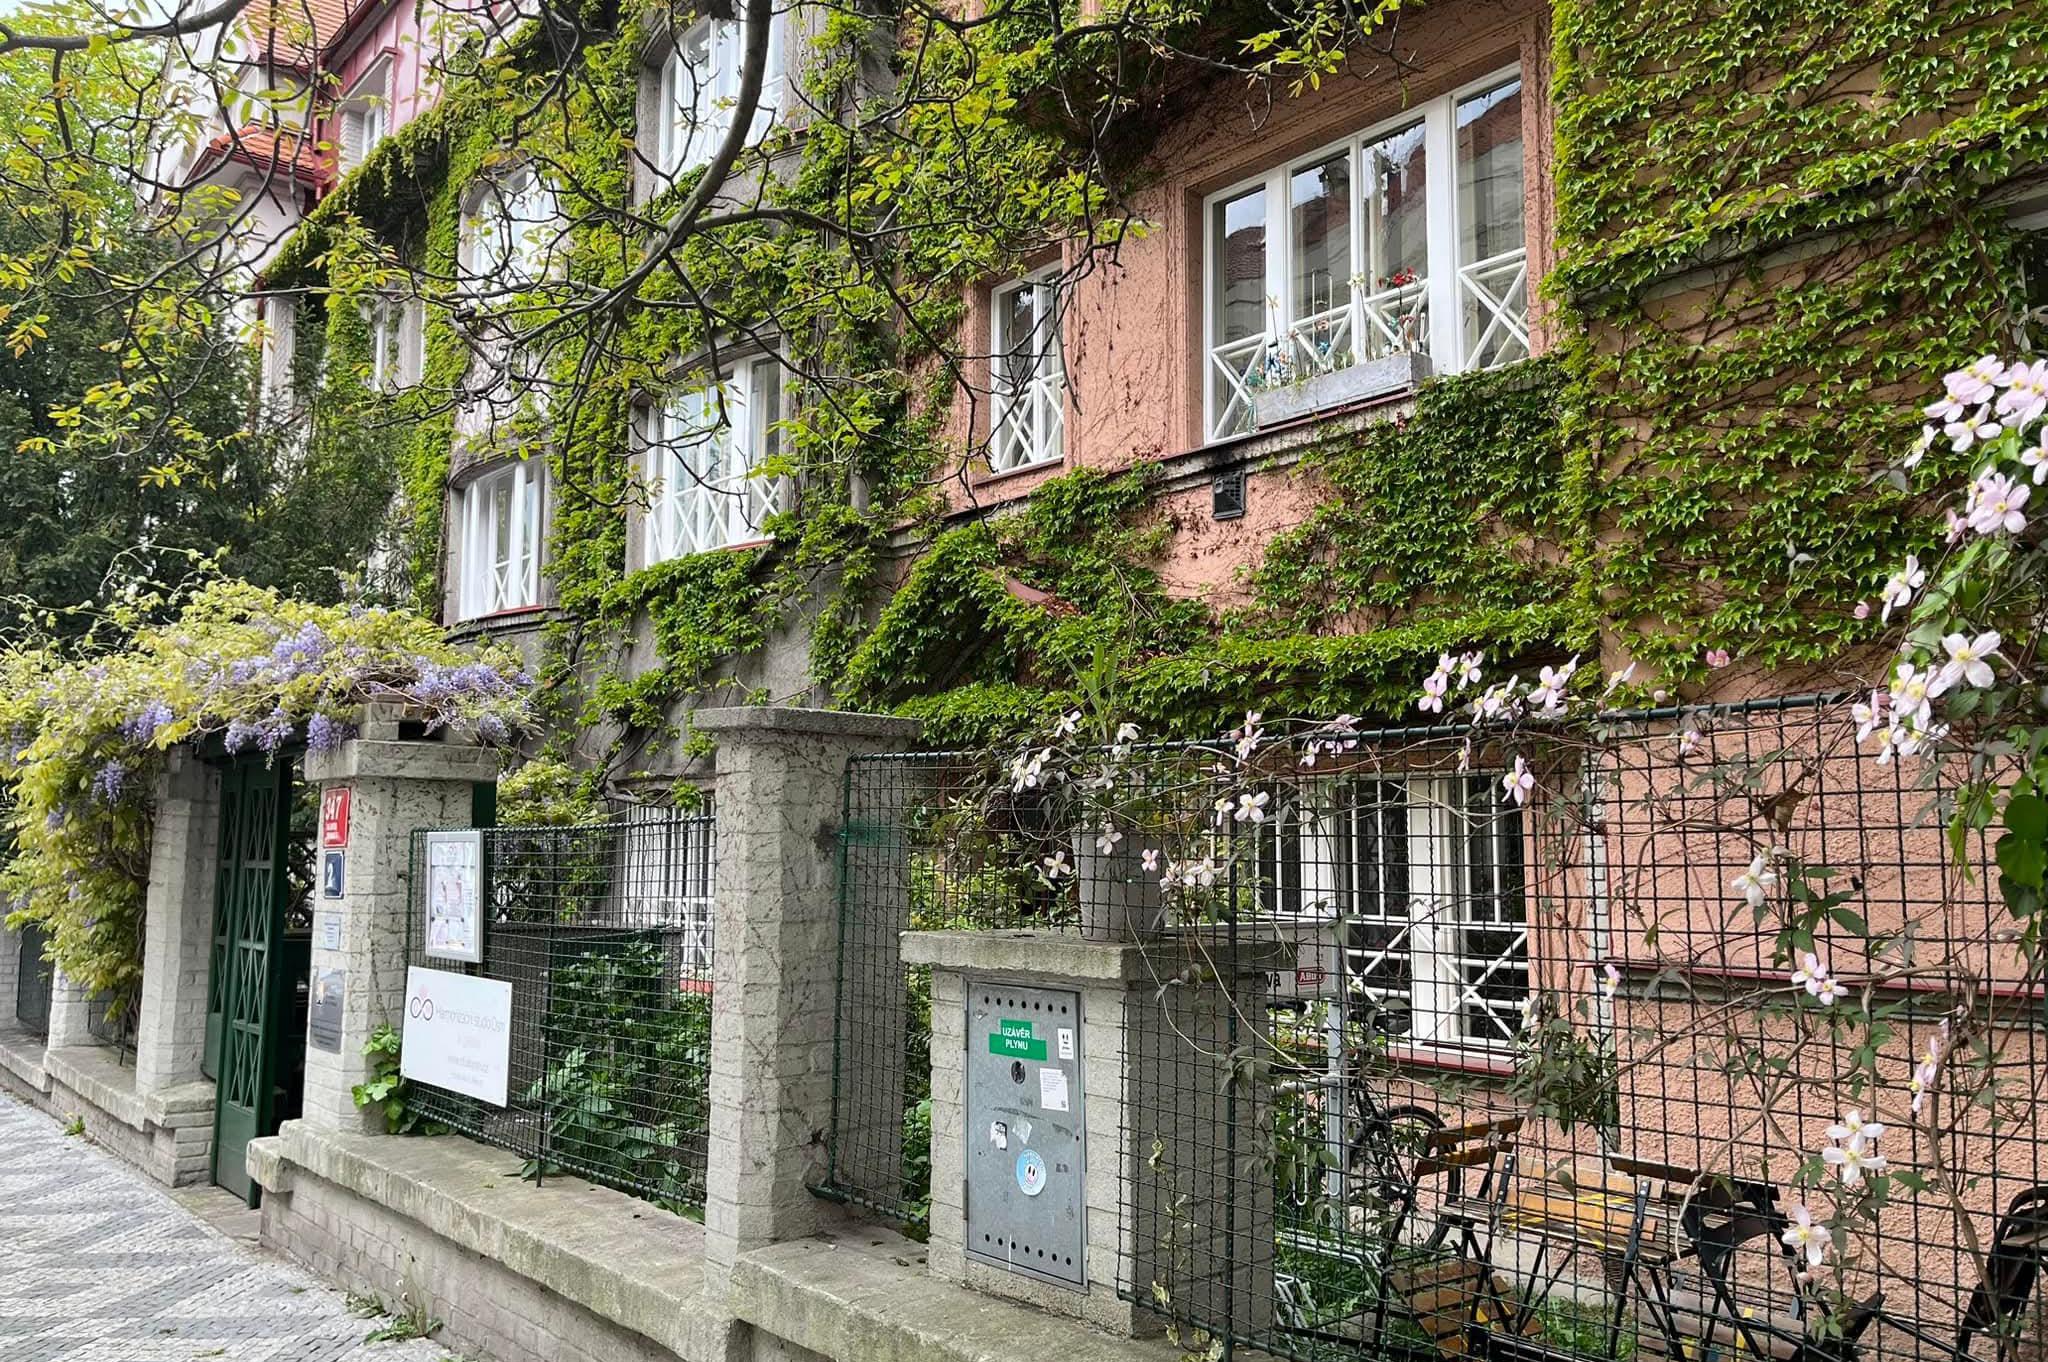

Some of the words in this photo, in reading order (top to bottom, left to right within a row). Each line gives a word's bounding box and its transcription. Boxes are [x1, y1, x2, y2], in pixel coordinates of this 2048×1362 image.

[325, 795, 342, 820] 347
[326, 863, 334, 888] 2
[1002, 1026, 1031, 1039] UZÁVĚR
[1005, 1038, 1028, 1050] PLYNU
